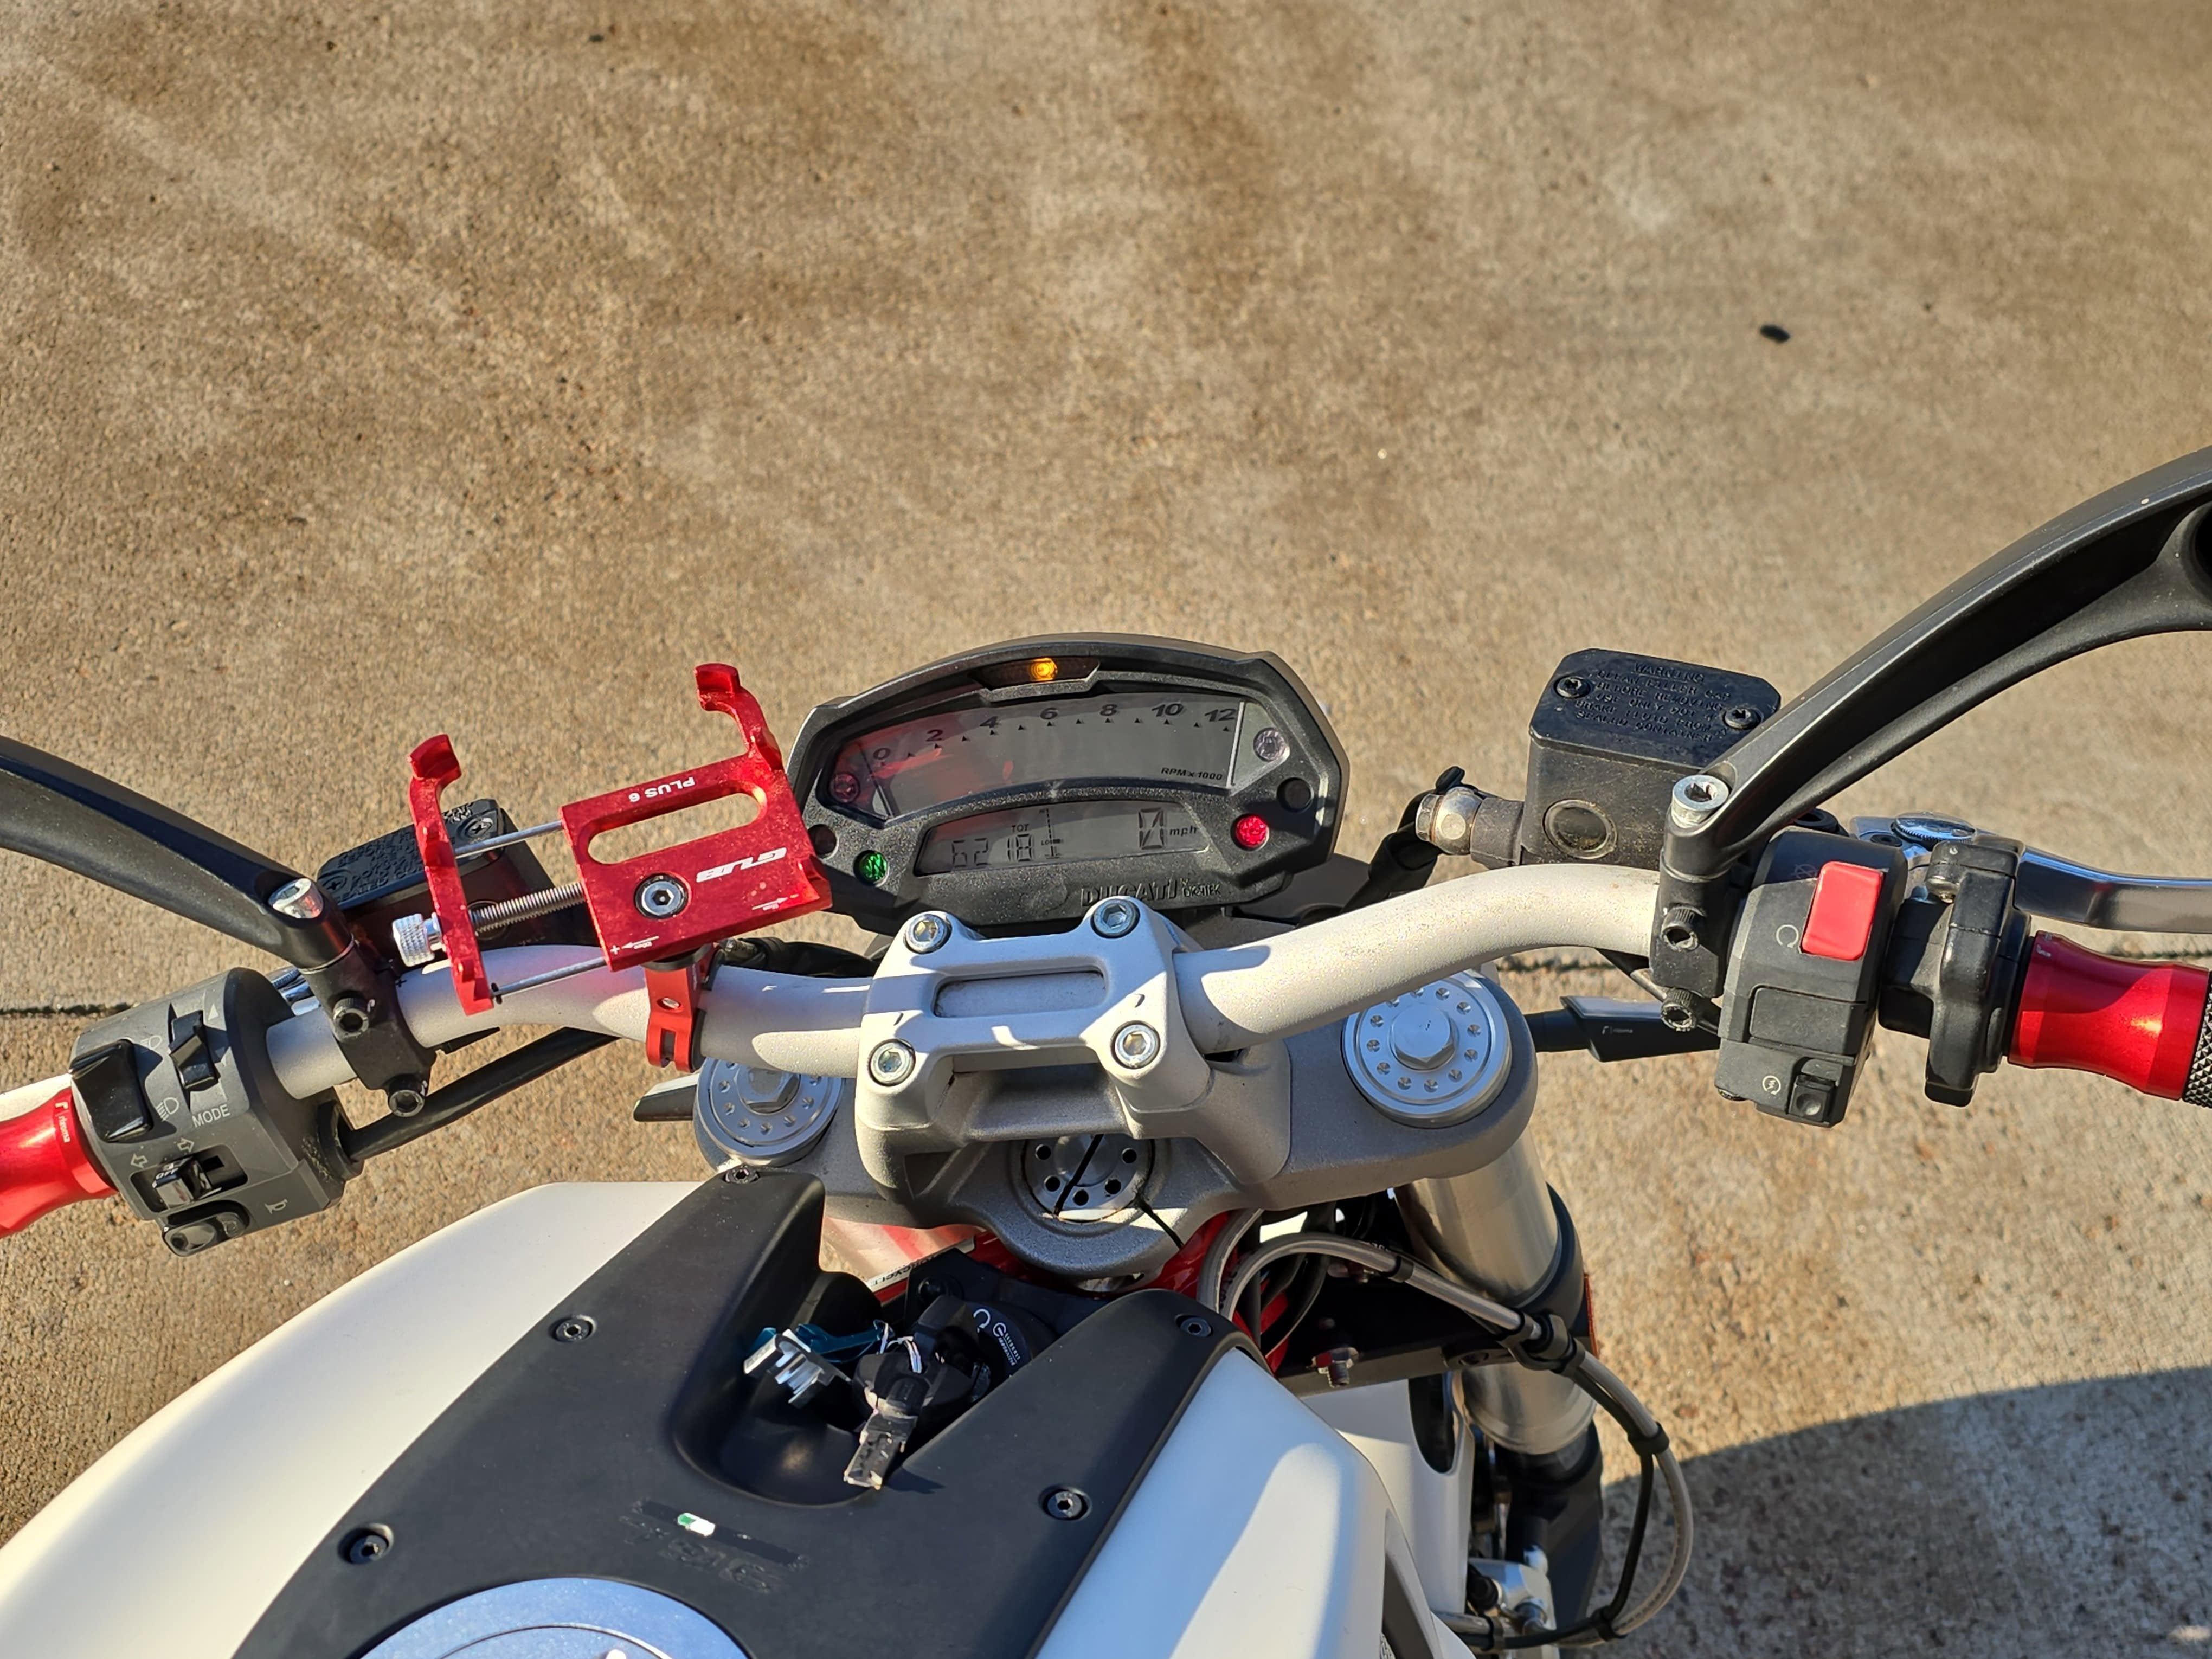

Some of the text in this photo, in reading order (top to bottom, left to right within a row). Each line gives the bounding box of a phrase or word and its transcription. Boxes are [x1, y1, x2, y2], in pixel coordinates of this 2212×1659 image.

[873, 703, 1237, 760] 0 2 4 6 8 10 12
[644, 776, 696, 798] PLUS
[1011, 824, 1030, 833] TOT
[1169, 825, 1198, 838] mph
[696, 847, 787, 883] GUB
[1081, 879, 1178, 907] DUCATI
[191, 1103, 231, 1128] MODE
[155, 1167, 179, 1180] OFF
